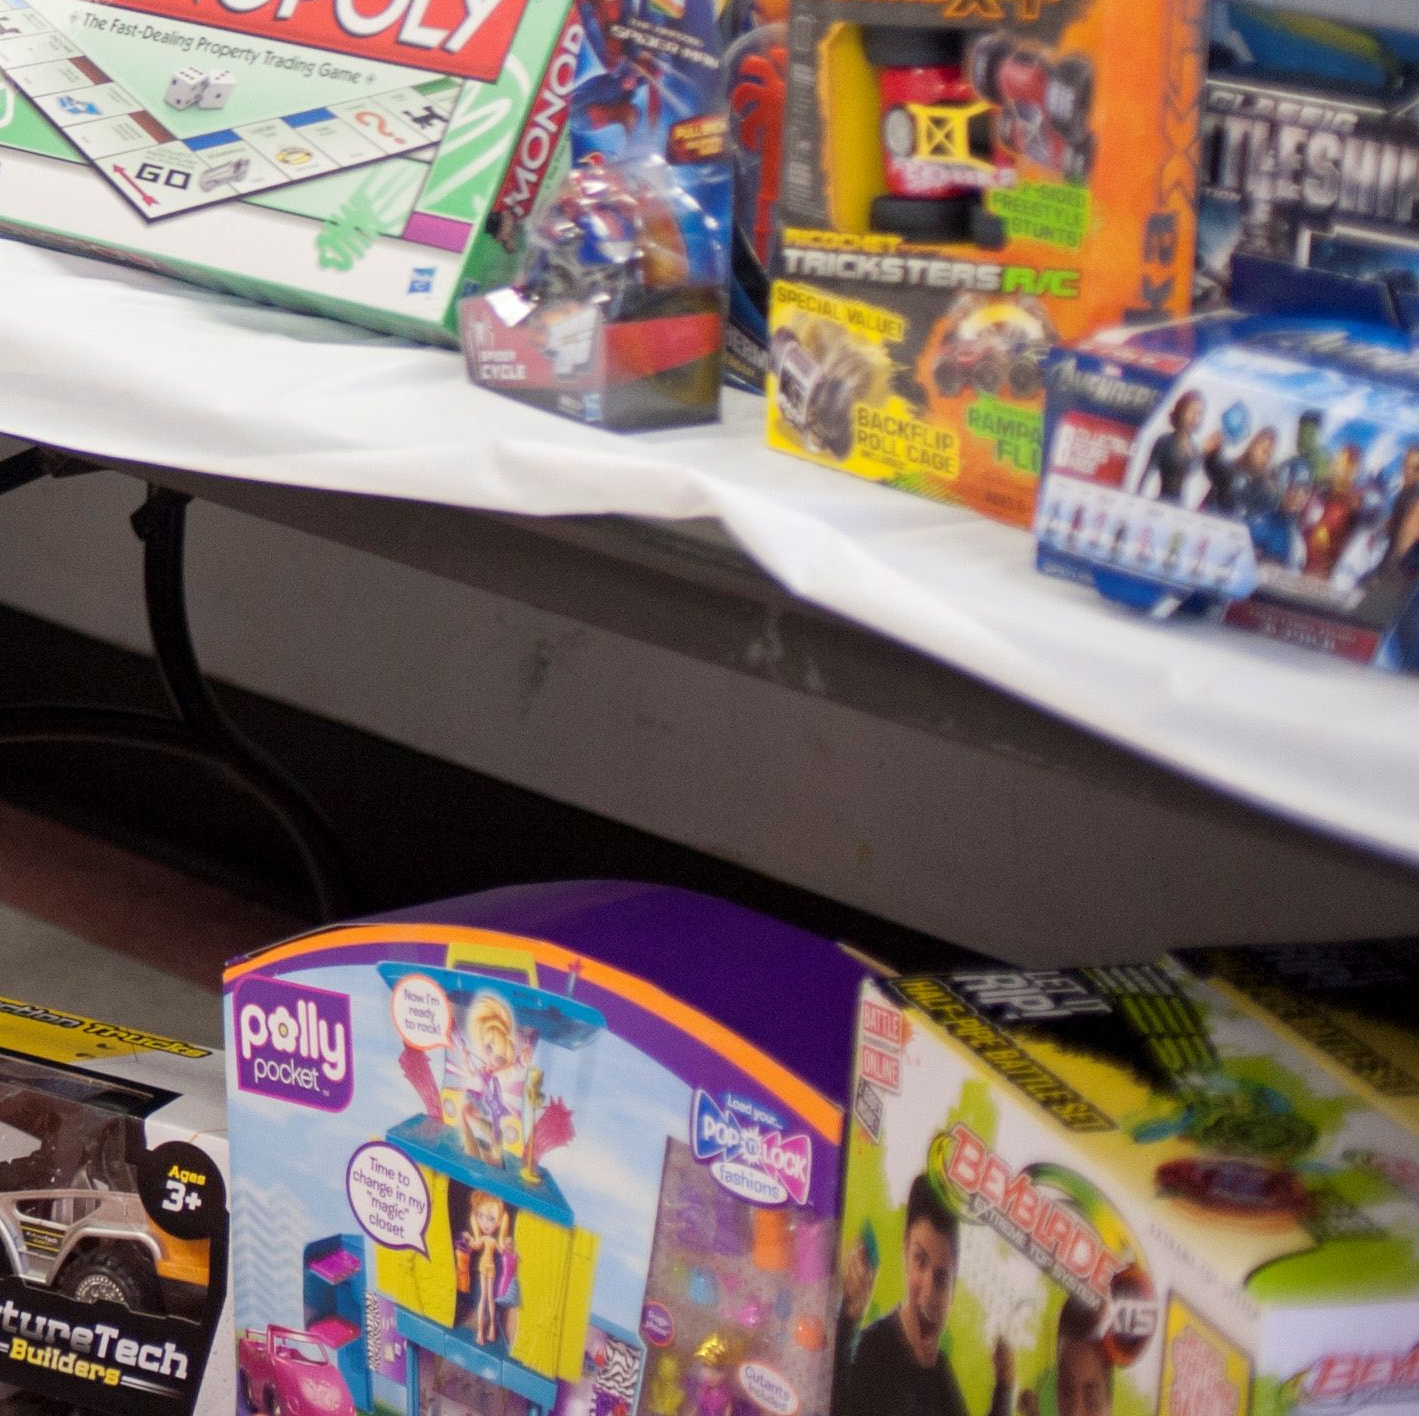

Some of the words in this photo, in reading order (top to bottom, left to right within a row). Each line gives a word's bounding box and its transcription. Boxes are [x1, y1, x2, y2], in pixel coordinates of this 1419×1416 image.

[84, 12, 108, 30] The
[110, 19, 193, 52] Fast-Dealing
[197, 39, 259, 66] Property
[264, 50, 314, 76] Trading
[318, 61, 362, 84] Game
[135, 163, 191, 190] GO
[783, 249, 1002, 291] TRICKSTERS
[1003, 266, 1080, 298] R/C
[777, 287, 841, 318] SPECIAL
[847, 306, 904, 338] VALUE!
[481, 363, 526, 380] CYCLE
[857, 406, 955, 452] BACKFLIP
[859, 430, 902, 460] ROLL
[907, 446, 955, 474] CAGE
[404, 988, 424, 1004] Now
[426, 991, 440, 1006] I'm
[409, 1005, 435, 1025] ready
[86, 1021, 212, 1058] Trucks
[241, 1000, 346, 1081] polly
[405, 1018, 416, 1029] to
[417, 1020, 441, 1035] rock!
[864, 1006, 900, 1042] BATTLE
[255, 1058, 320, 1091] pocket
[863, 1048, 900, 1084] ONLINE
[727, 1095, 750, 1117] Load
[751, 1106, 783, 1131] your...
[703, 1116, 736, 1148] POP
[763, 1143, 808, 1179] LOCK
[168, 1166, 205, 1185] Ages
[369, 1156, 395, 1179] Time
[399, 1171, 410, 1186] to
[720, 1164, 781, 1200] fashions
[163, 1180, 202, 1212] 3+
[353, 1169, 394, 1200] change
[396, 1187, 406, 1202] in
[409, 1196, 425, 1214] my
[369, 1211, 405, 1239] closet
[948, 1125, 1119, 1296] BEYBLADE
[1099, 1299, 1157, 1335] XTS
[10, 1338, 121, 1386] Builders
